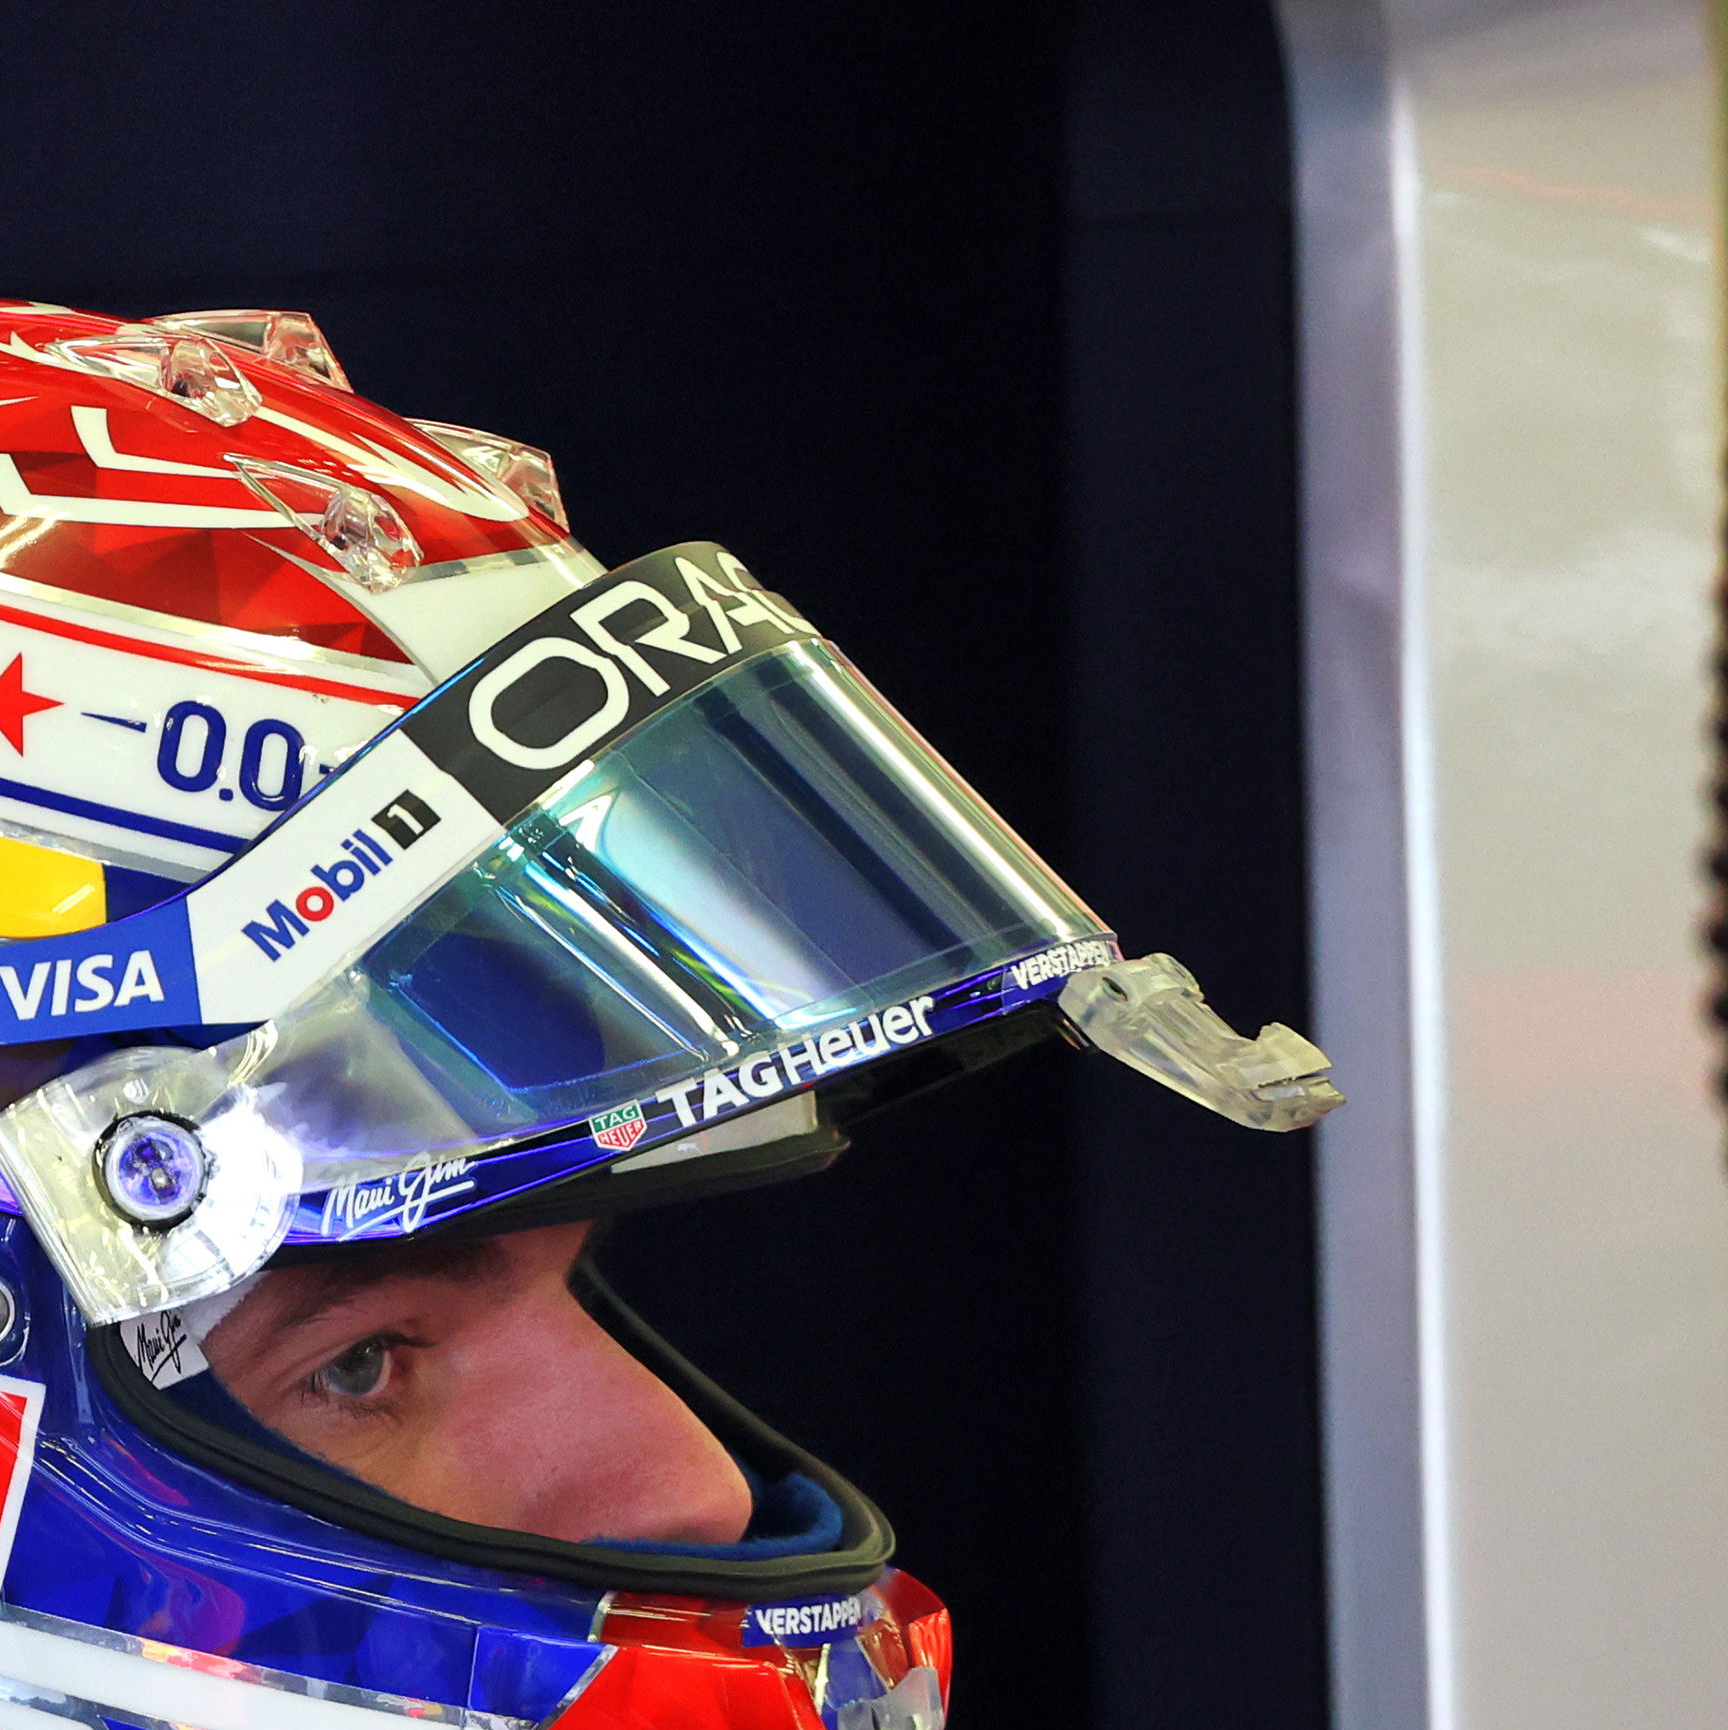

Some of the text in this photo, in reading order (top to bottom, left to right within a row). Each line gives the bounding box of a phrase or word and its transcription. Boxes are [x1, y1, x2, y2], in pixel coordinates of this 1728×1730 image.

[241, 829, 393, 962] Mobil
[594, 1105, 637, 1131] TAG
[597, 1119, 643, 1148] HEUER
[320, 1171, 395, 1237] Maui
